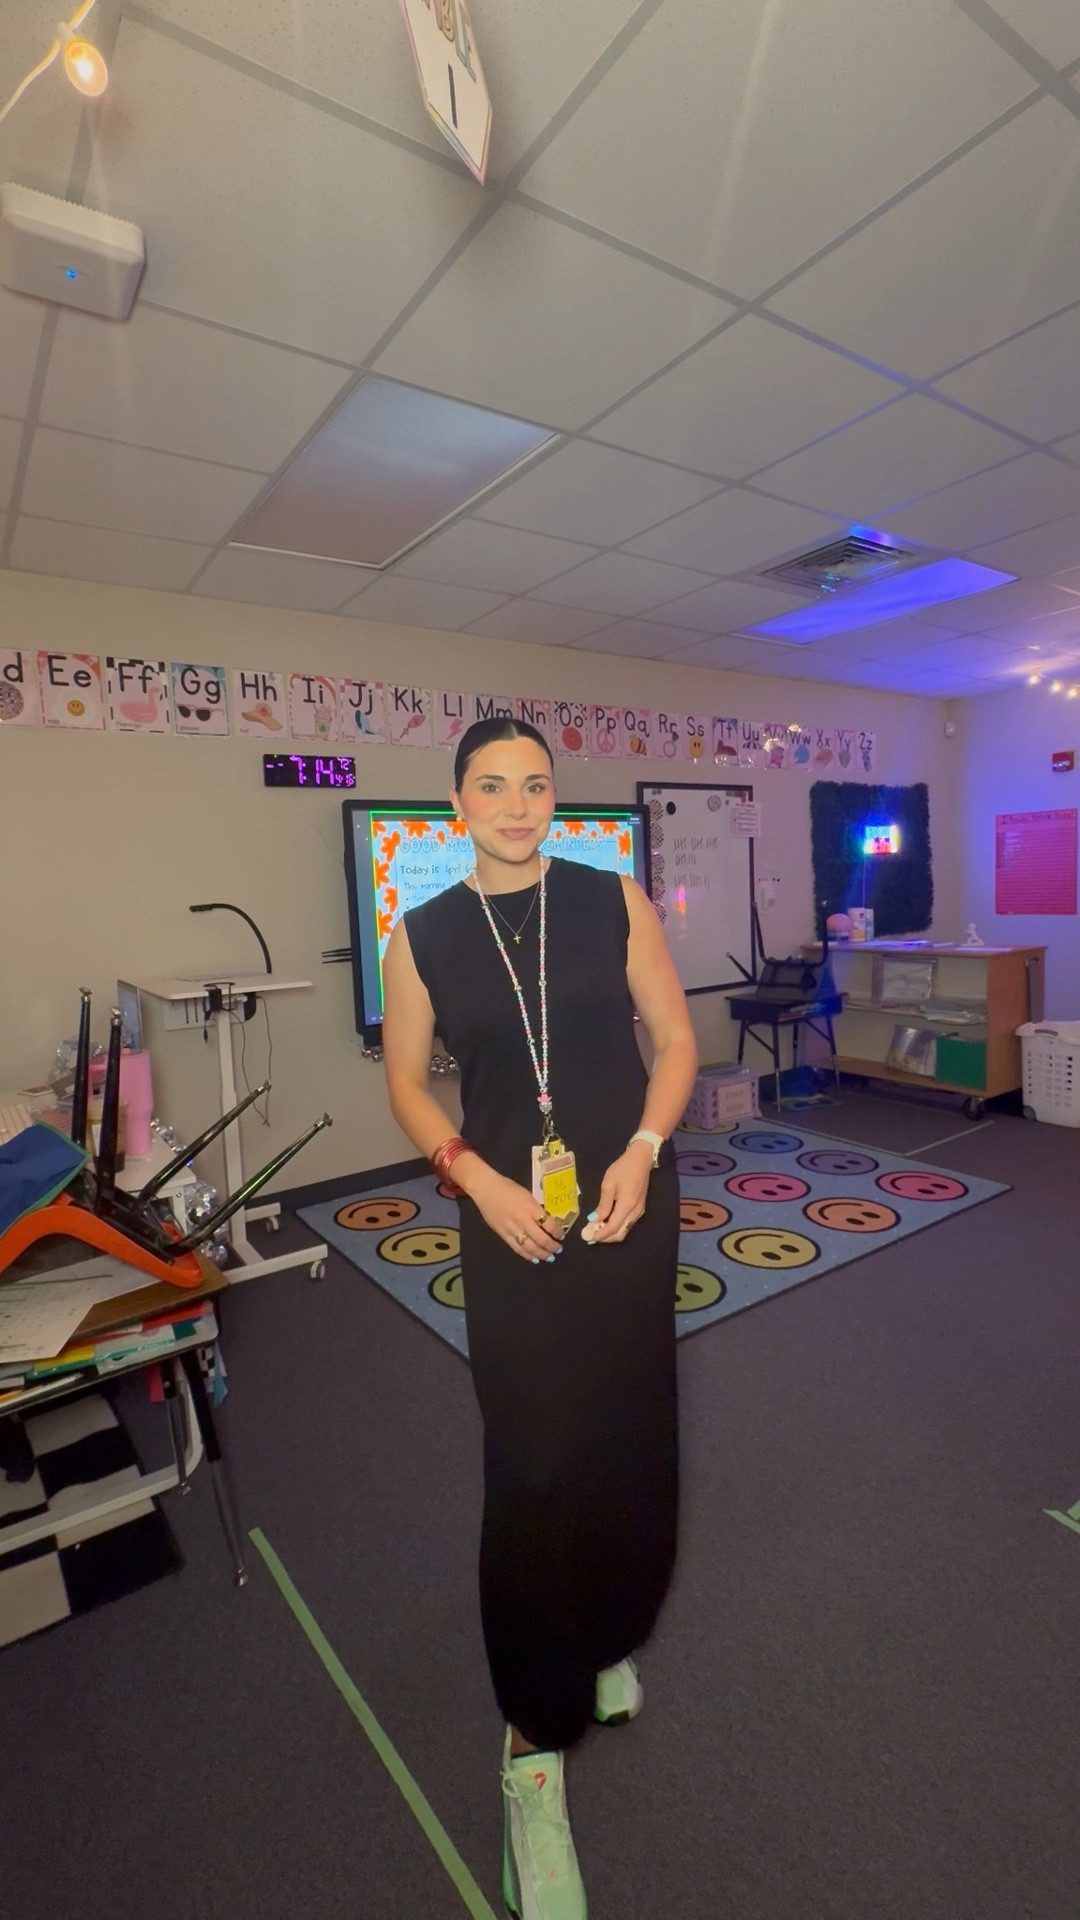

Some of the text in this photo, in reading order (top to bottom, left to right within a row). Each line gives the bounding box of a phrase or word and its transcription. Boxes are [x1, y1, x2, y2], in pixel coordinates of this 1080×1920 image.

[47, 655, 92, 687] Ee
[117, 662, 155, 694] Ff
[180, 667, 221, 704] Gg
[240, 672, 277, 701] Hh
[302, 677, 324, 704] Ii
[349, 682, 373, 715] Jj
[394, 687, 423, 714] Kk
[443, 693, 463, 718] Ll
[475, 697, 513, 720] Mm
[520, 701, 546, 725] Nn
[559, 704, 584, 728] Oo
[595, 708, 617, 734] Pp
[624, 711, 650, 737] Qq
[658, 713, 678, 734] Rr
[686, 716, 705, 737] Ss
[742, 722, 760, 741] Uu
[816, 729, 831, 747] Xx
[837, 729, 851, 752] Yy
[858, 732, 873, 750] Zz
[400, 836, 441, 853] GOOD
[400, 864, 429, 876] Today
[431, 864, 440, 874] is
